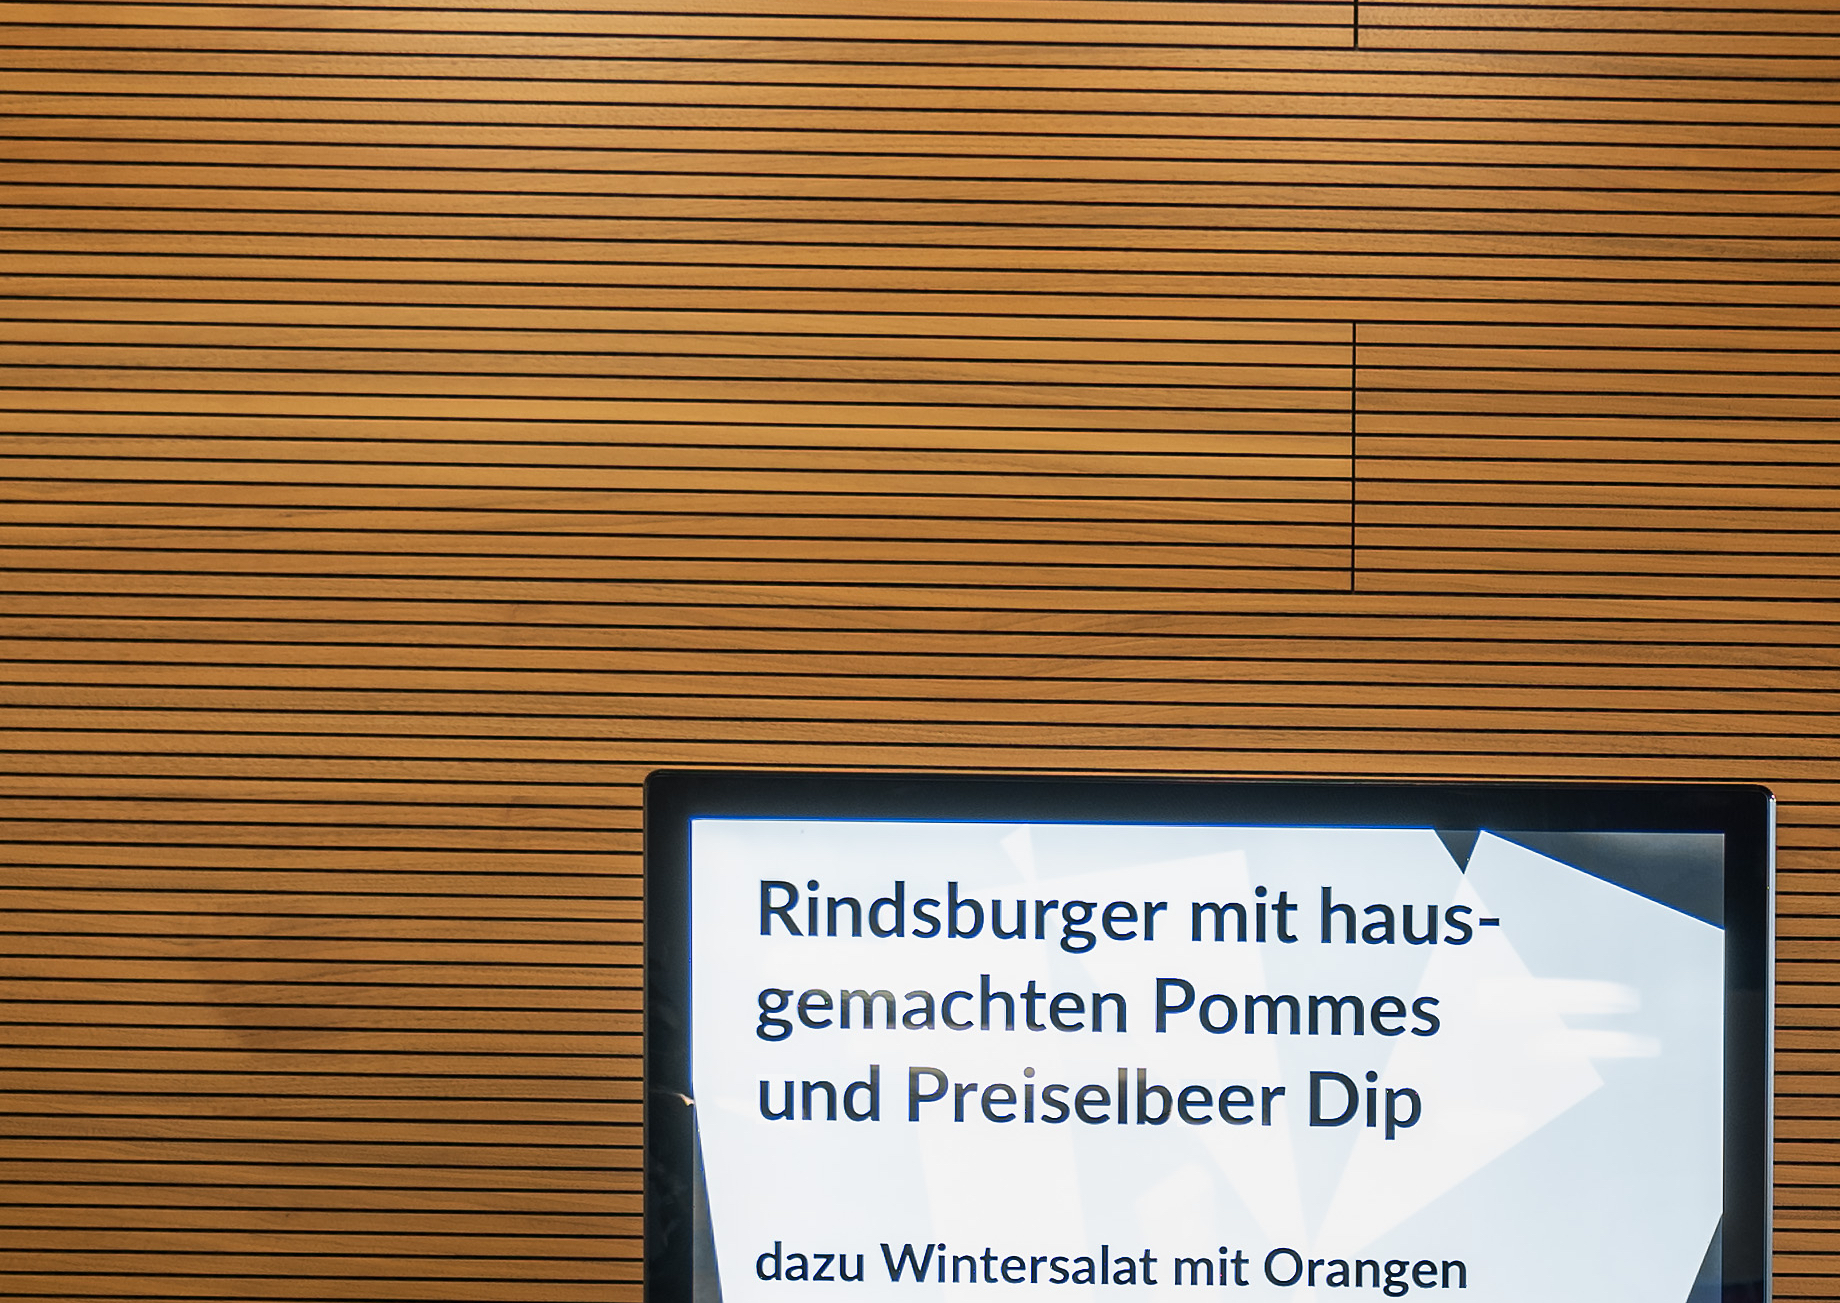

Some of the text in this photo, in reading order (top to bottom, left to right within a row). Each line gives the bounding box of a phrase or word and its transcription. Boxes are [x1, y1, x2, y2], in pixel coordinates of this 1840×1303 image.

[758, 879, 1501, 956] Rindsburger mit haus-
[755, 973, 1441, 1042] gemachten Pommes
[759, 1064, 1422, 1141] und Preiselbeer Dip
[755, 1240, 1468, 1298] dazu Wintersalat mit Orangen
